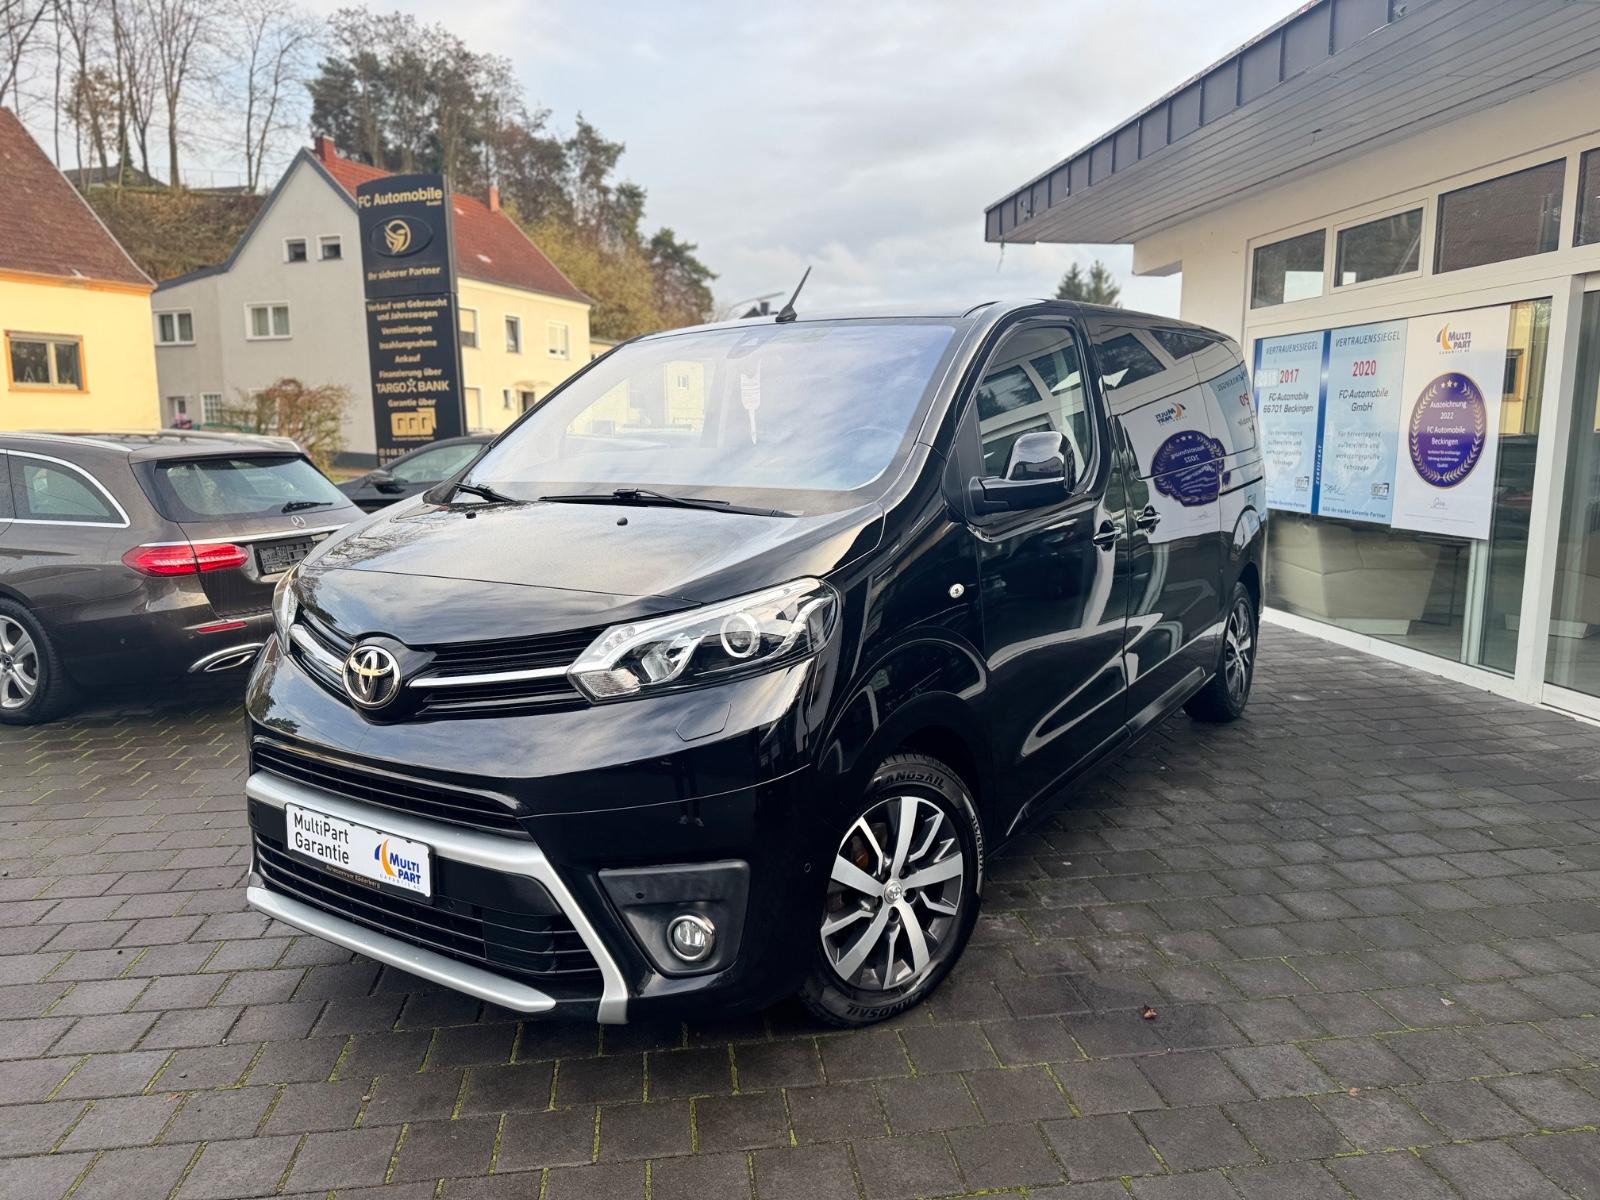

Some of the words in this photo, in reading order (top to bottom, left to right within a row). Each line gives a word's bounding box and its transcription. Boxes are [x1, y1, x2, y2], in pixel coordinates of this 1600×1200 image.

[358, 195, 372, 208] FC
[373, 187, 443, 206] Automobile
[409, 267, 441, 276] Partner
[1336, 331, 1400, 347] VERTRAUENSSIEGEL
[1448, 331, 1472, 341] MULTI
[1266, 340, 1319, 355] VERTRAUENSSIEGEL
[1453, 340, 1472, 350] PART
[395, 354, 421, 364] Ankauf
[1352, 360, 1377, 377] 2020
[1279, 368, 1299, 384] 2017
[1283, 403, 1314, 415] Beckingen
[1351, 402, 1374, 412] GmbH
[1430, 400, 1467, 409] Auszeichnung
[1440, 411, 1454, 420] 2022
[1434, 425, 1466, 434] Automobile
[1431, 437, 1459, 446] Beckingen
[293, 812, 350, 845] MultiPart
[295, 832, 350, 865] Garantie
[389, 852, 420, 873] MULTI
[398, 870, 421, 885] PART
